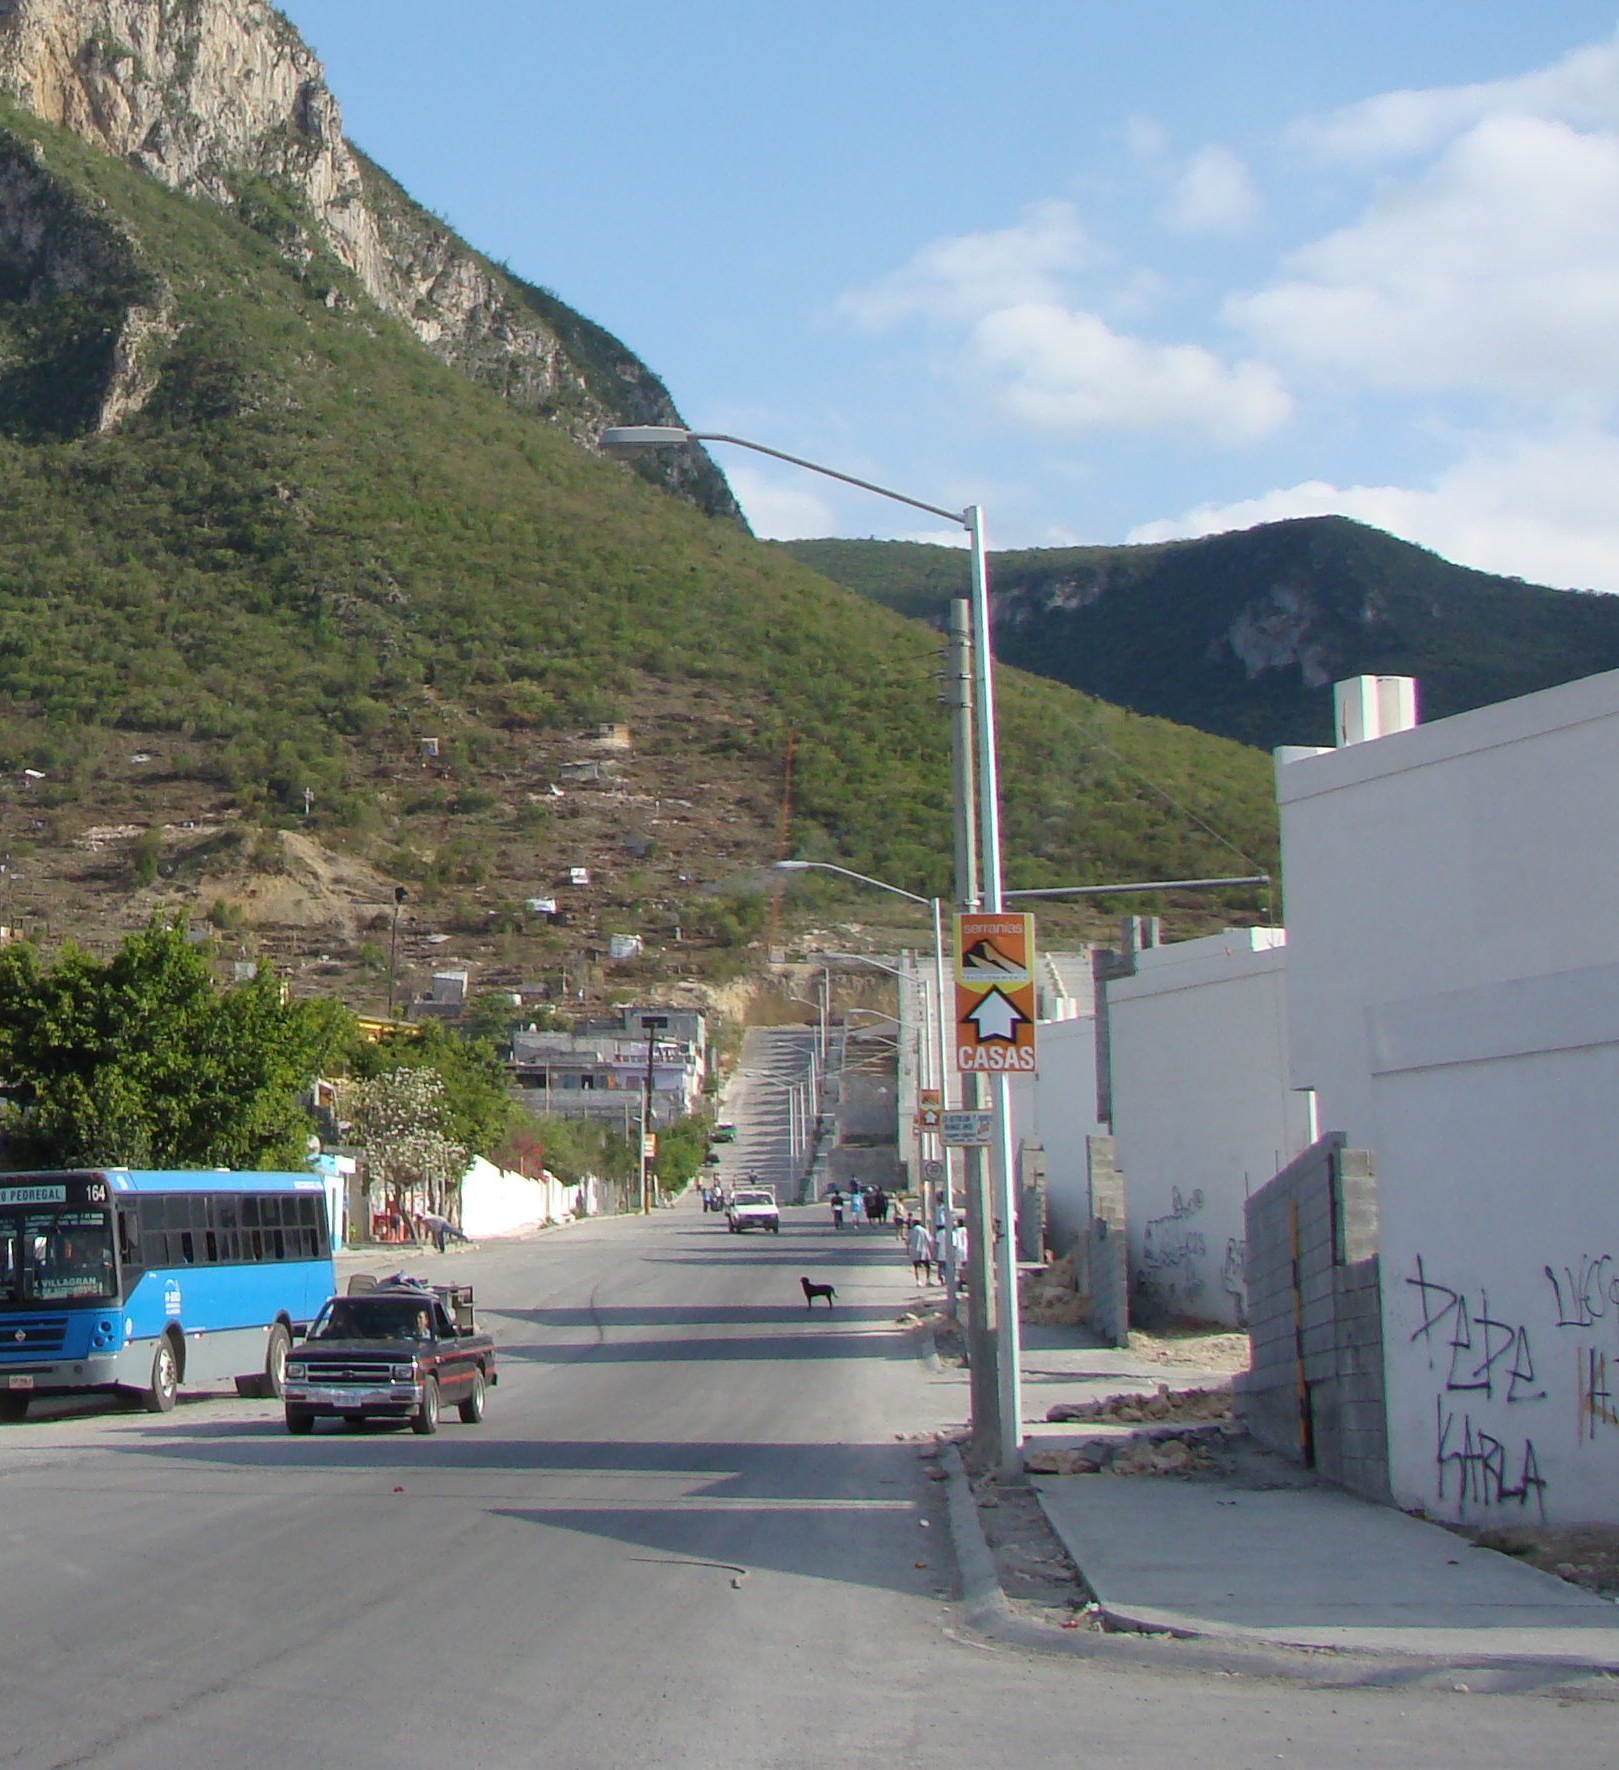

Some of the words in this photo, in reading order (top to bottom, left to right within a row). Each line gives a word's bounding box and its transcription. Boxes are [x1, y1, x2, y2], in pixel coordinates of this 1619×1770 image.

[958, 1045, 1035, 1070] CASAS
[10, 1187, 61, 1202] PEDREGAL
[86, 1184, 106, 1202] 164
[1436, 1394, 1547, 1520] KARLA
